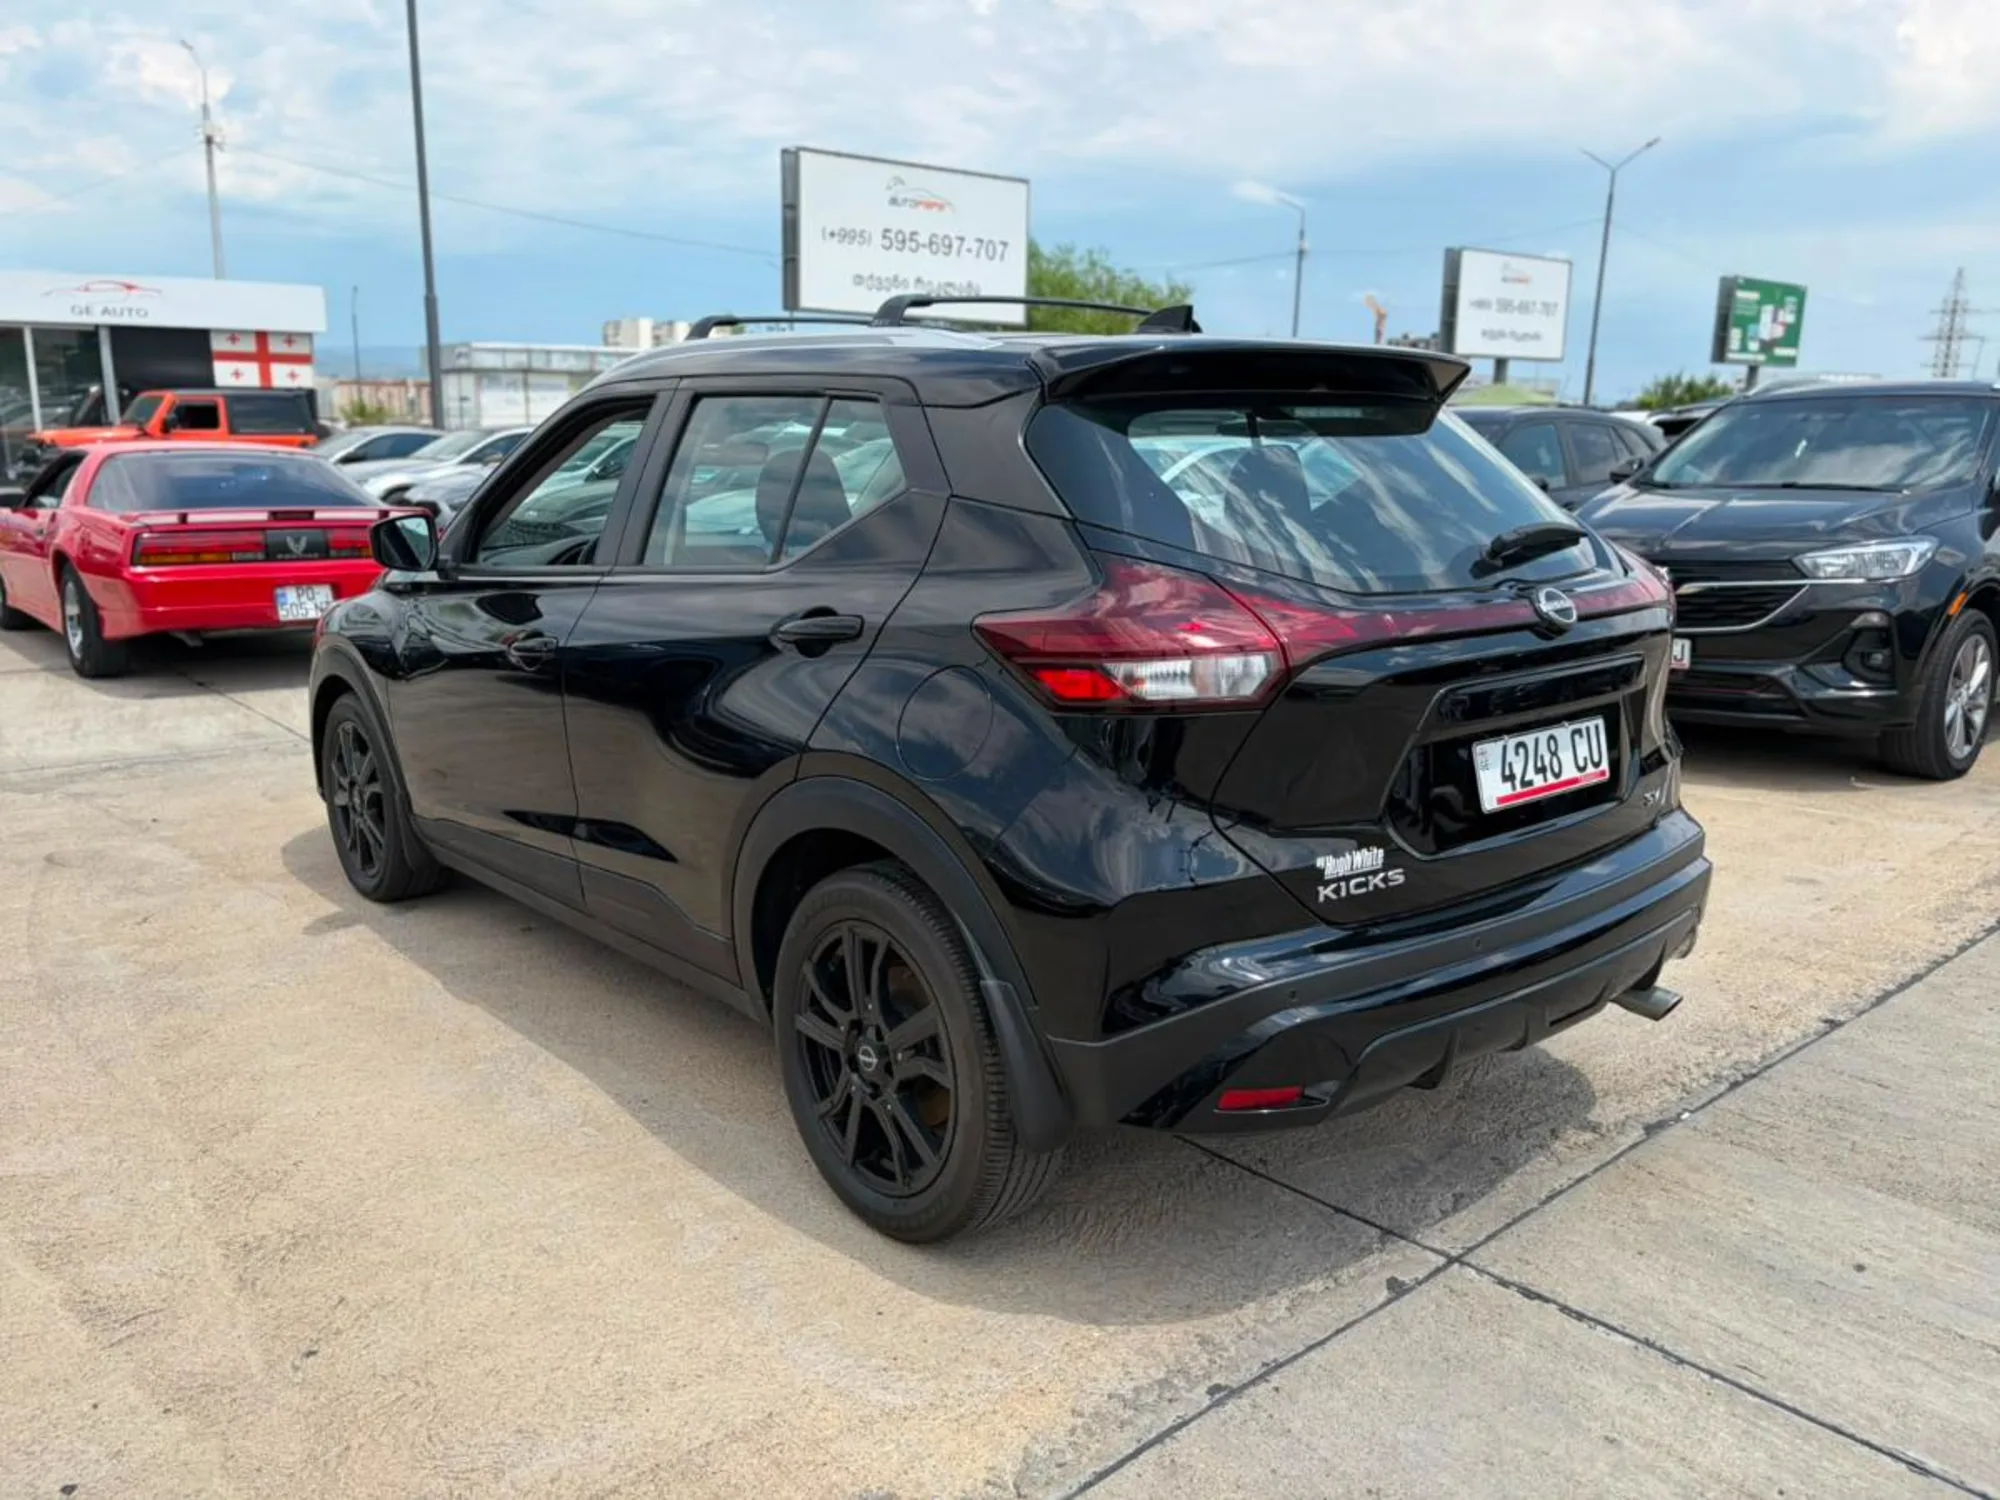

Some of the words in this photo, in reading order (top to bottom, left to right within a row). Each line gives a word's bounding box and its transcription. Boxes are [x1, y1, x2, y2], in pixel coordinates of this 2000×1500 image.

[821, 226, 873, 247] (+995)
[880, 228, 1009, 262] 595-697-707
[101, 305, 149, 318] AUTO
[1501, 734, 1562, 791] 4248
[1569, 723, 1603, 773] CU
[1316, 868, 1405, 902] KICKS
